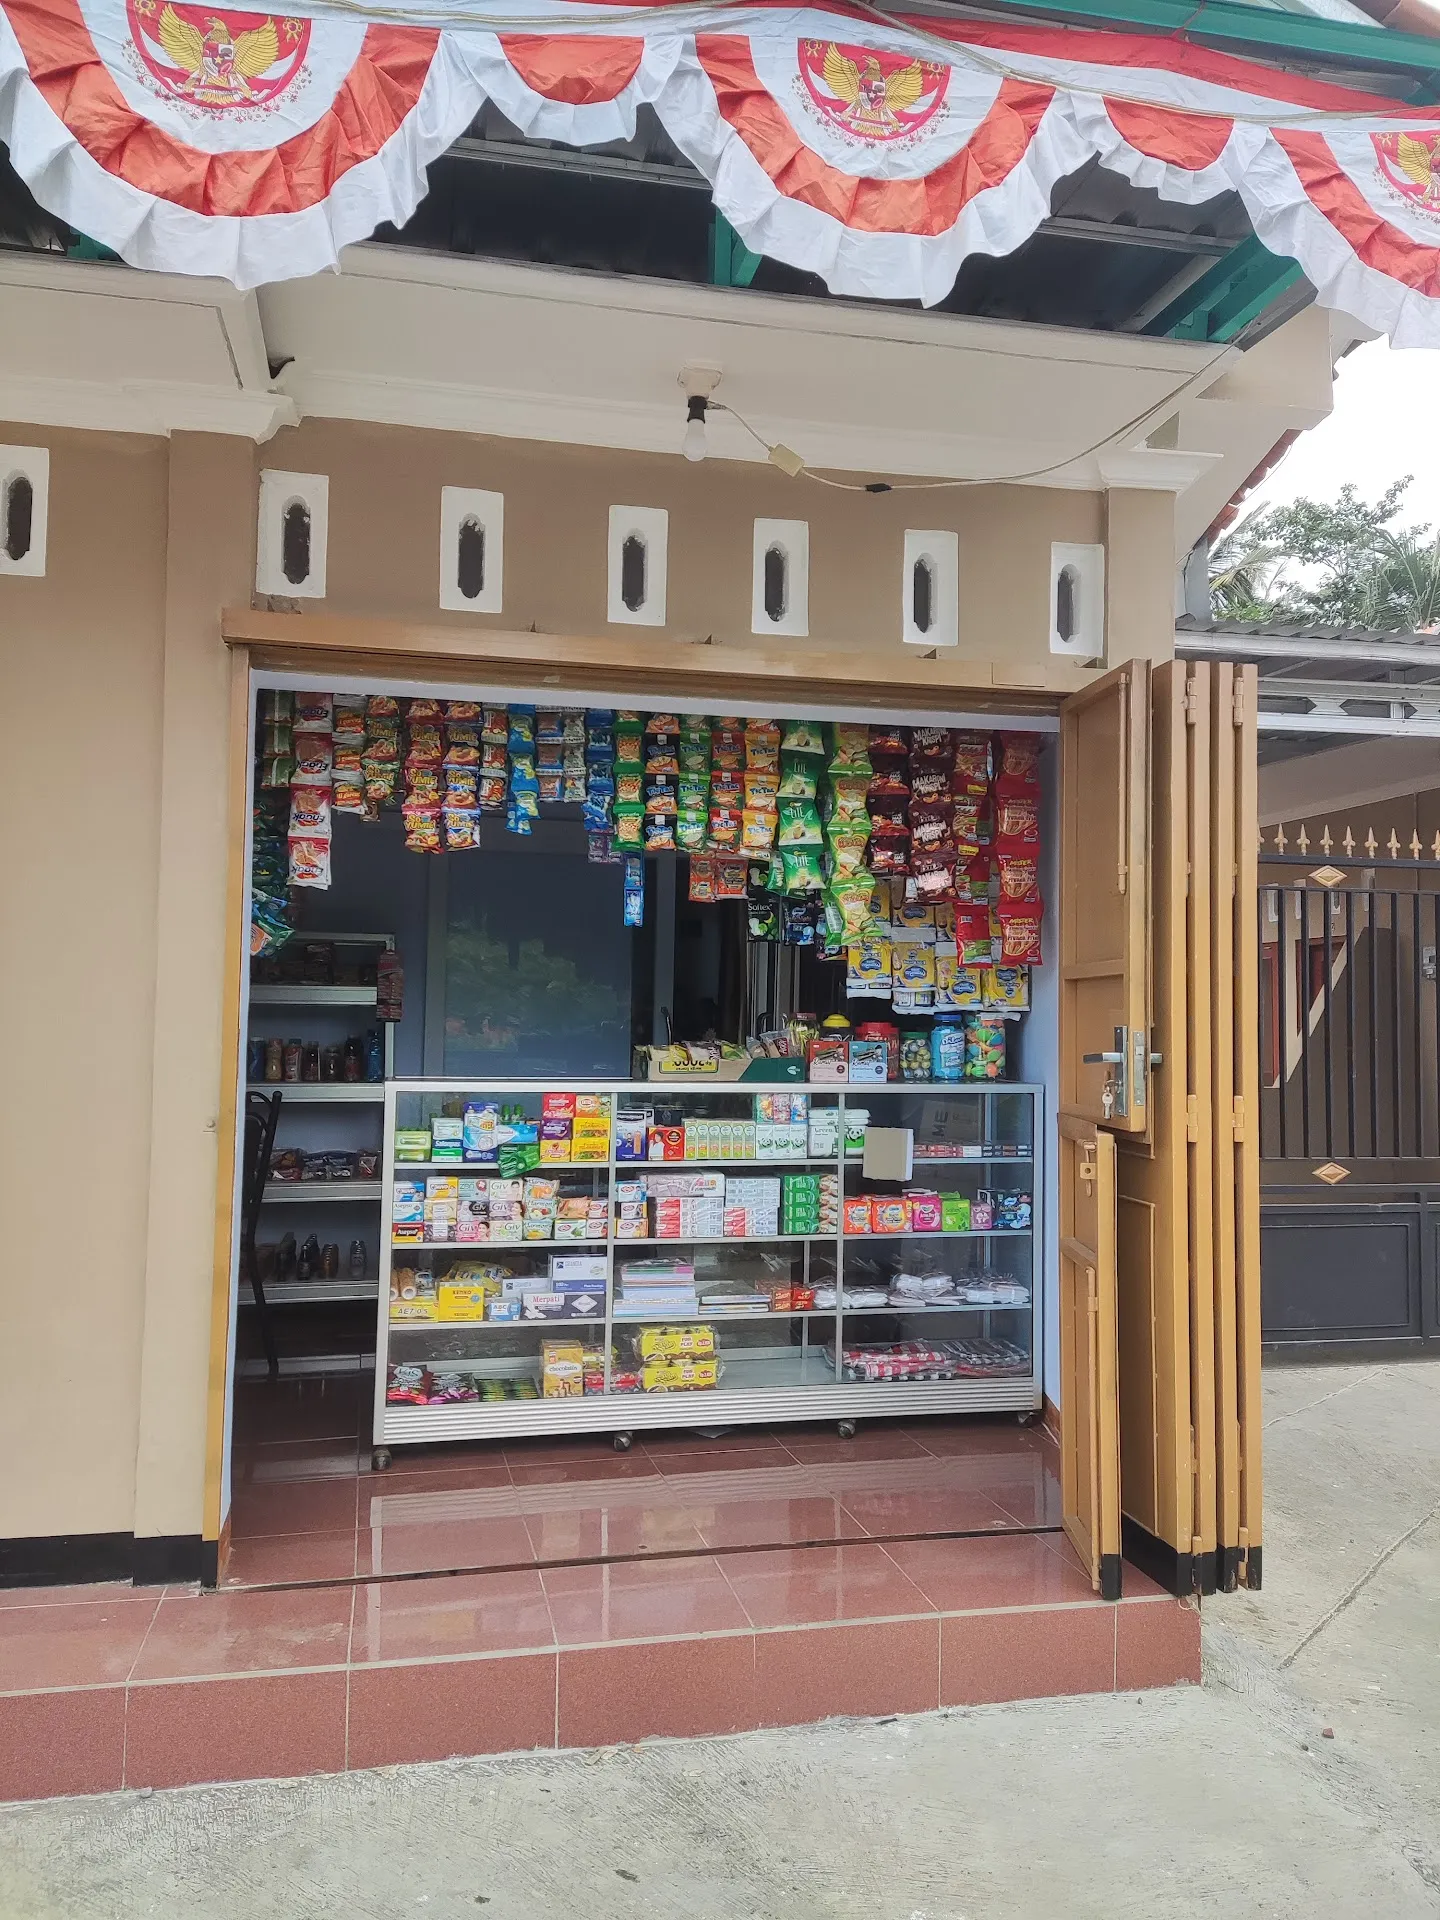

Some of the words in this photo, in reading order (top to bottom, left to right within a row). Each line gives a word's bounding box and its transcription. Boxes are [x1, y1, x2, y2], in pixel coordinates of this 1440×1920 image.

[748, 903, 771, 911] Softex
[491, 1181, 508, 1190] Giv
[491, 1202, 509, 1211] Giv
[532, 1295, 560, 1304] Merpati
